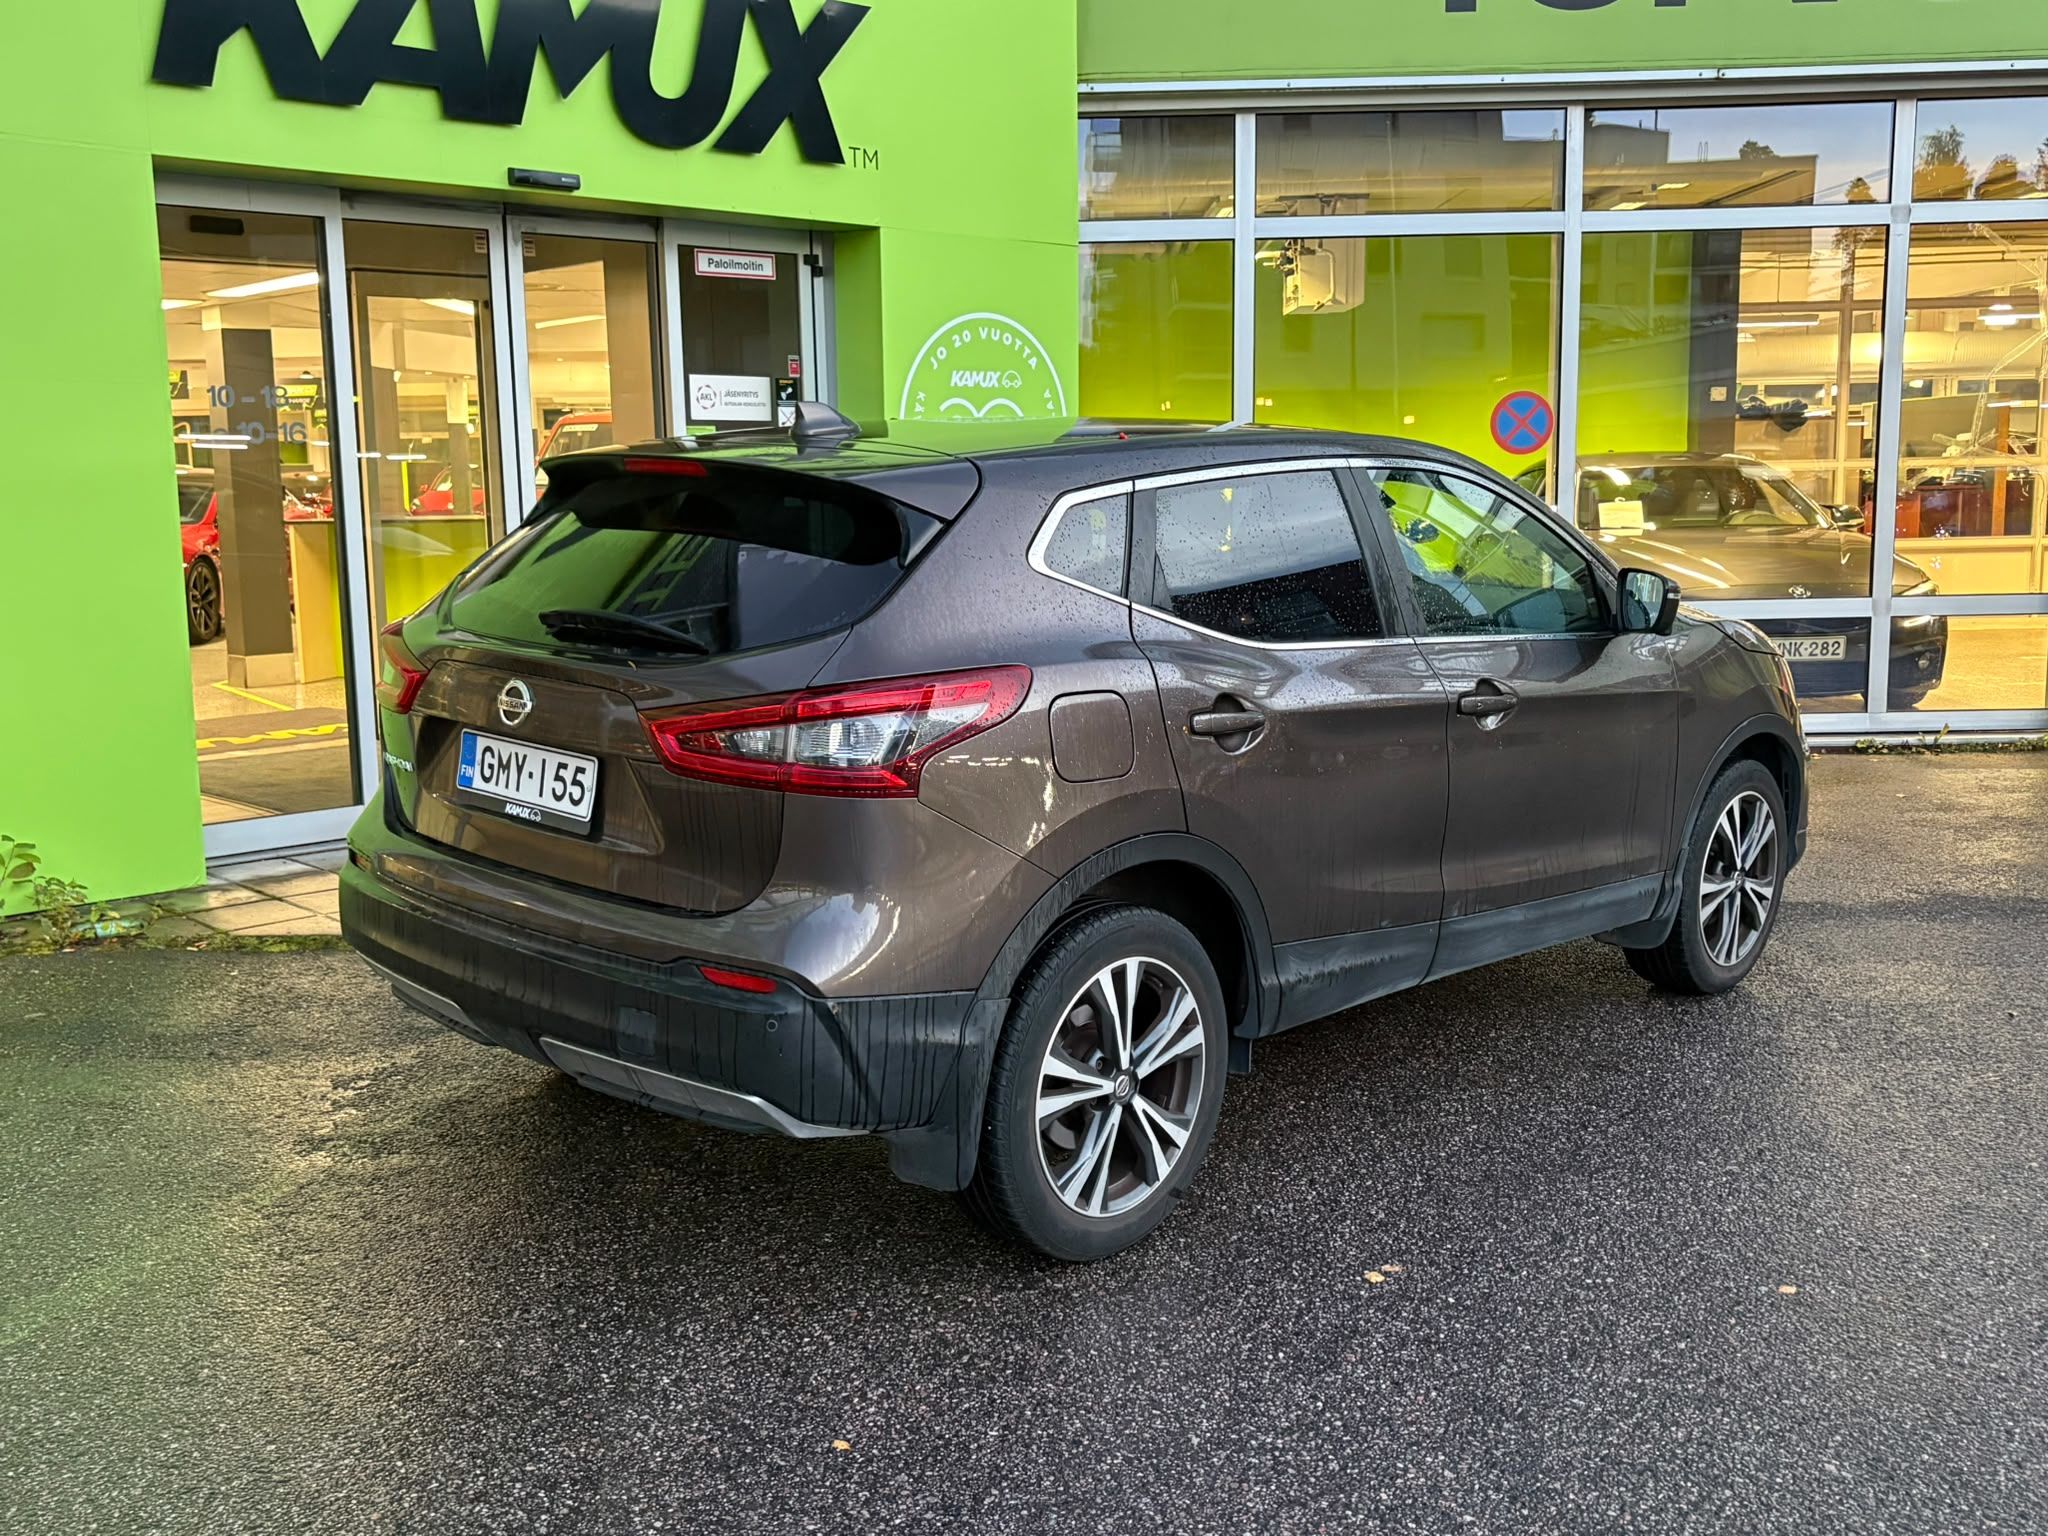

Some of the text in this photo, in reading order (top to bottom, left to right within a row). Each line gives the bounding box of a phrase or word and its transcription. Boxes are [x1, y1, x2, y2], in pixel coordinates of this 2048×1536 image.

[152, 0, 871, 164] KAMUX
[707, 257, 764, 272] Paloilmoitin
[930, 326, 1039, 370] JO 20 VUOTTA
[951, 370, 1001, 388] KAMUX
[700, 392, 713, 402] AKL
[723, 389, 759, 399] JÄSENYRITYS
[499, 698, 528, 711] NISSAN
[460, 764, 474, 779] FIN
[480, 745, 587, 807] GMY-155
[504, 802, 531, 819] KAMUX
